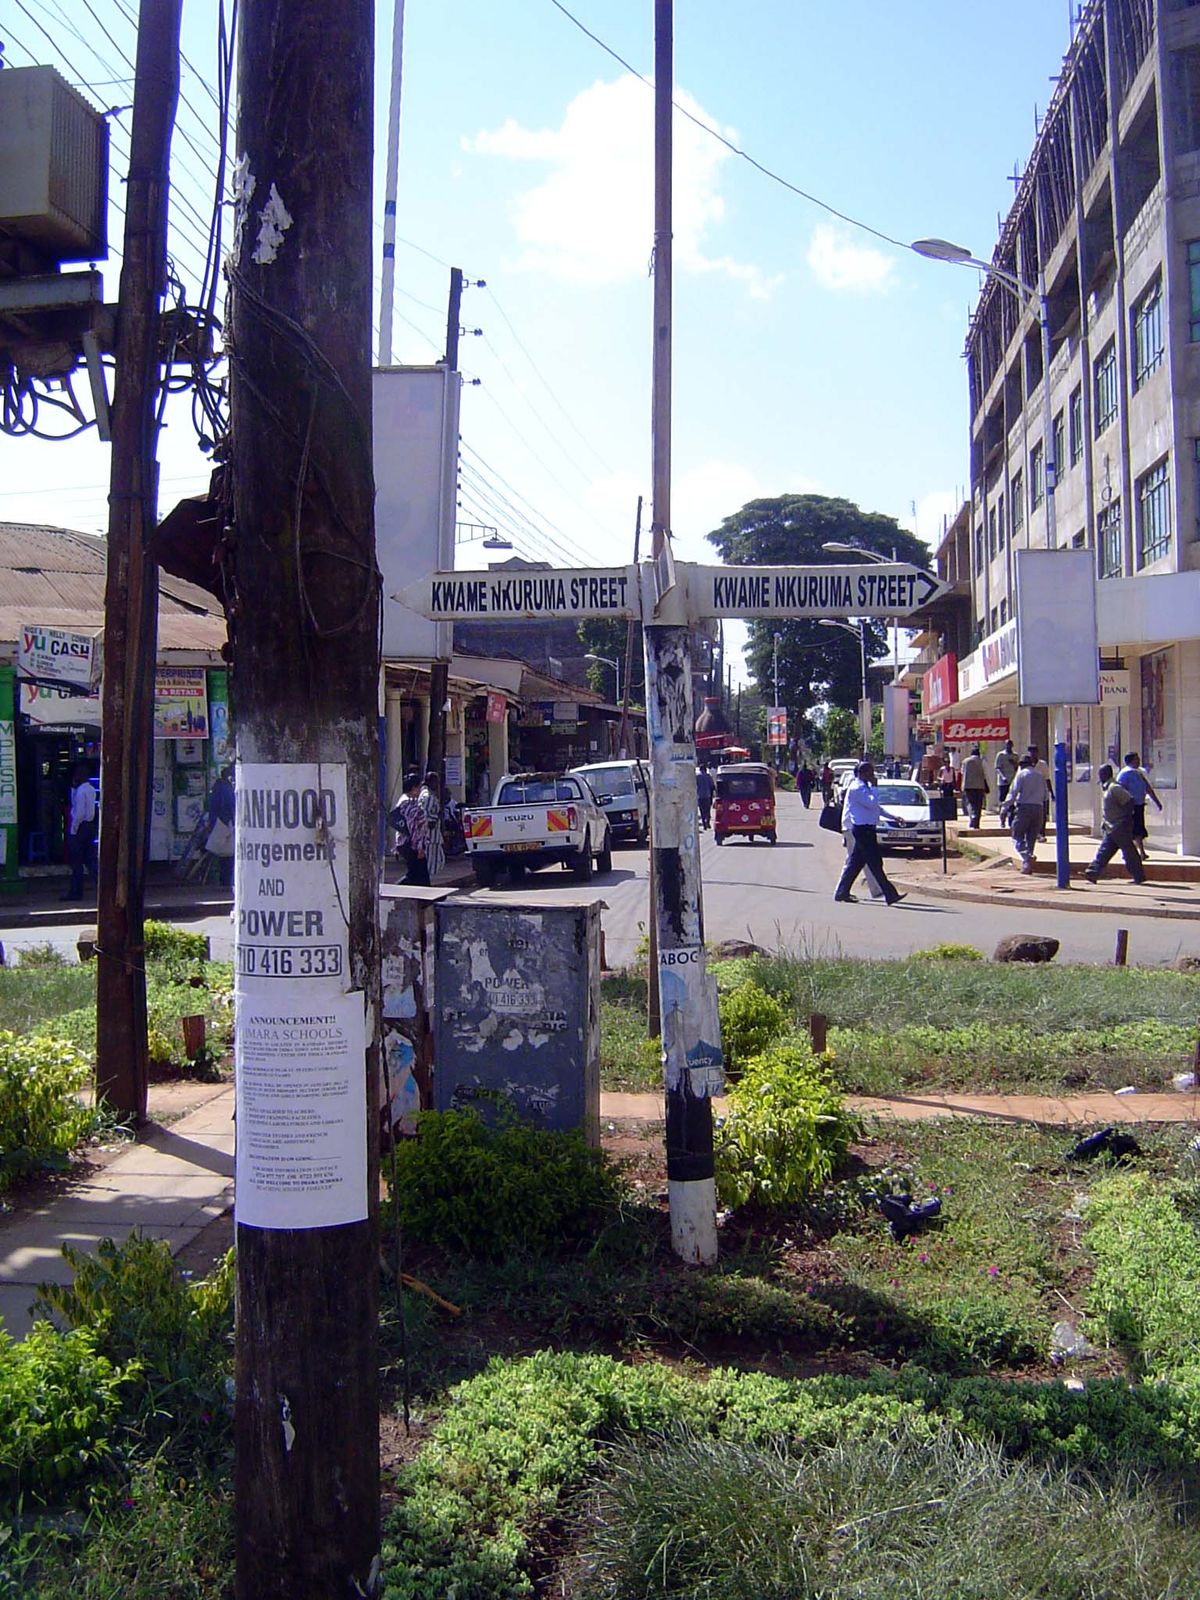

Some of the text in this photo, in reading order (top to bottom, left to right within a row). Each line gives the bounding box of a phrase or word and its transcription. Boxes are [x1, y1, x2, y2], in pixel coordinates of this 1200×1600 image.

[431, 576, 628, 612] KWAME NKURUMA STREET
[713, 574, 921, 608] KWAME NKURUMA STREET
[24, 633, 90, 656] yu CASH
[1104, 686, 1128, 694] BANK
[945, 723, 1008, 738] Bata
[504, 814, 535, 822] ISUZU
[259, 878, 285, 897] AND
[260, 948, 292, 975] 416
[300, 948, 339, 974] 333
[249, 1014, 336, 1026] ANNOUNCEMENT!!
[243, 1027, 343, 1040] IMARA SCHOOLS
